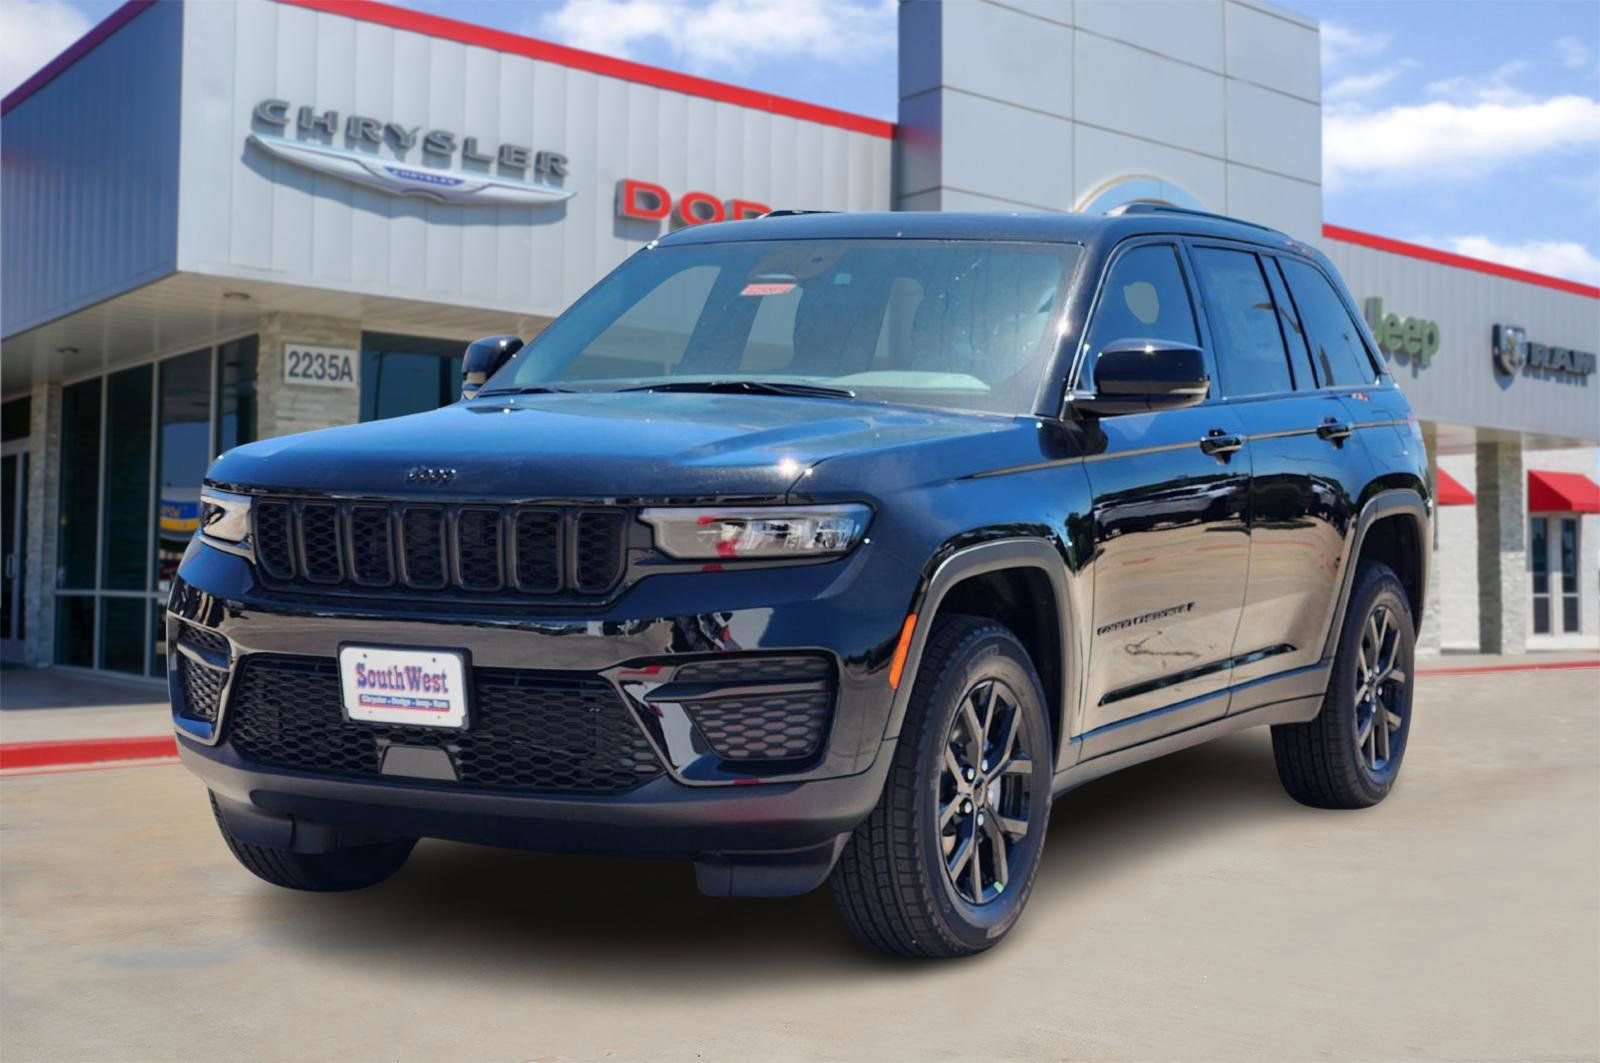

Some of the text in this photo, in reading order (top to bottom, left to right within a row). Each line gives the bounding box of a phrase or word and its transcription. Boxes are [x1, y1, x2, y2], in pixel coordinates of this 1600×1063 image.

[251, 98, 569, 177] CHRYSLER
[288, 350, 354, 383] 2235A
[1526, 342, 1597, 376] RAM
[356, 662, 449, 694] SouthWest
